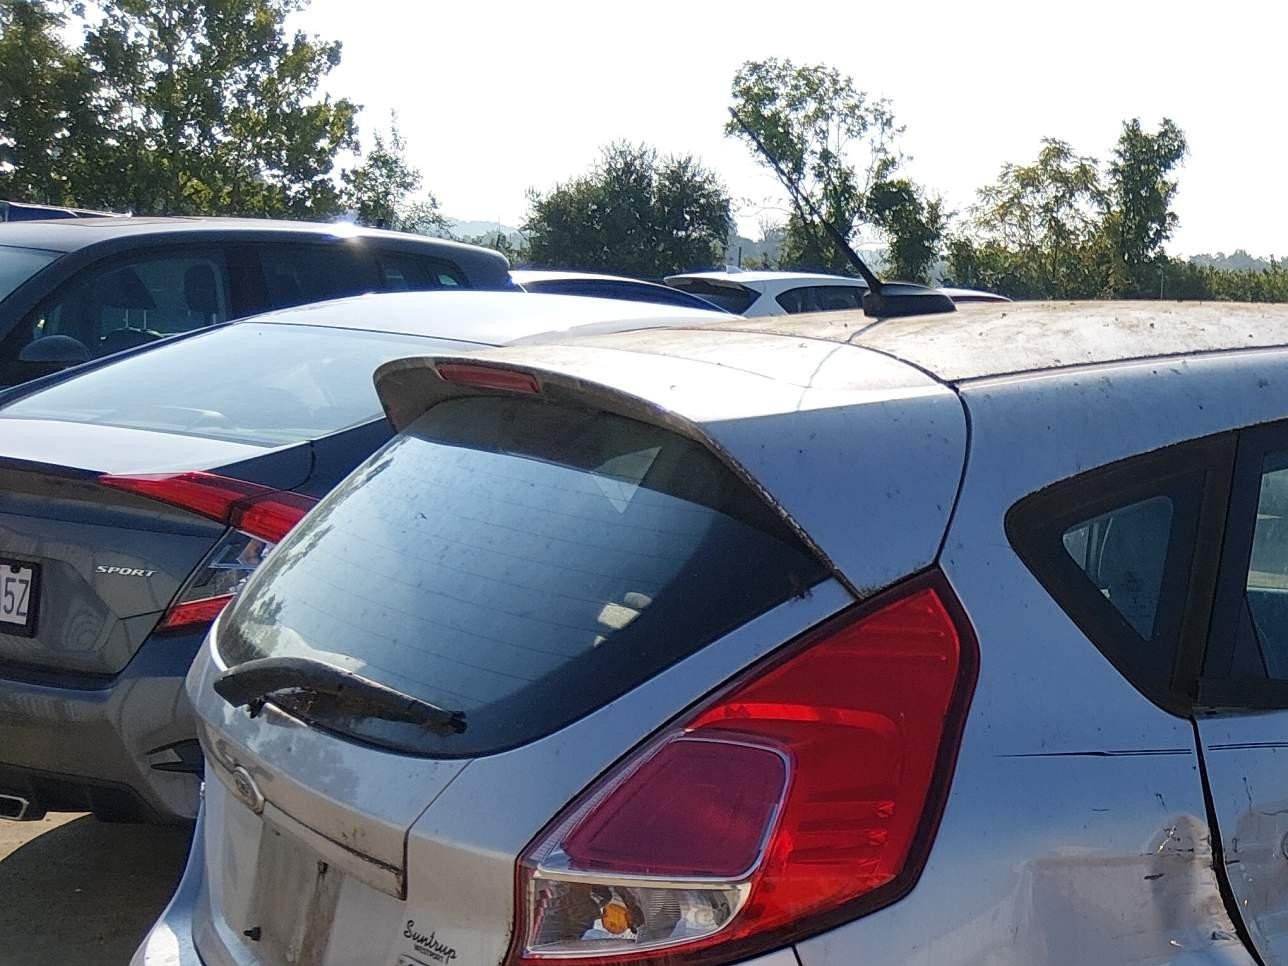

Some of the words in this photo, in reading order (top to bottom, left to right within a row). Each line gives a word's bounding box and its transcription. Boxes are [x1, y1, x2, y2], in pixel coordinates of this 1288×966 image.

[95, 565, 158, 577] SPORT
[0, 577, 29, 616] 5Z
[403, 919, 457, 965] Suntrup
